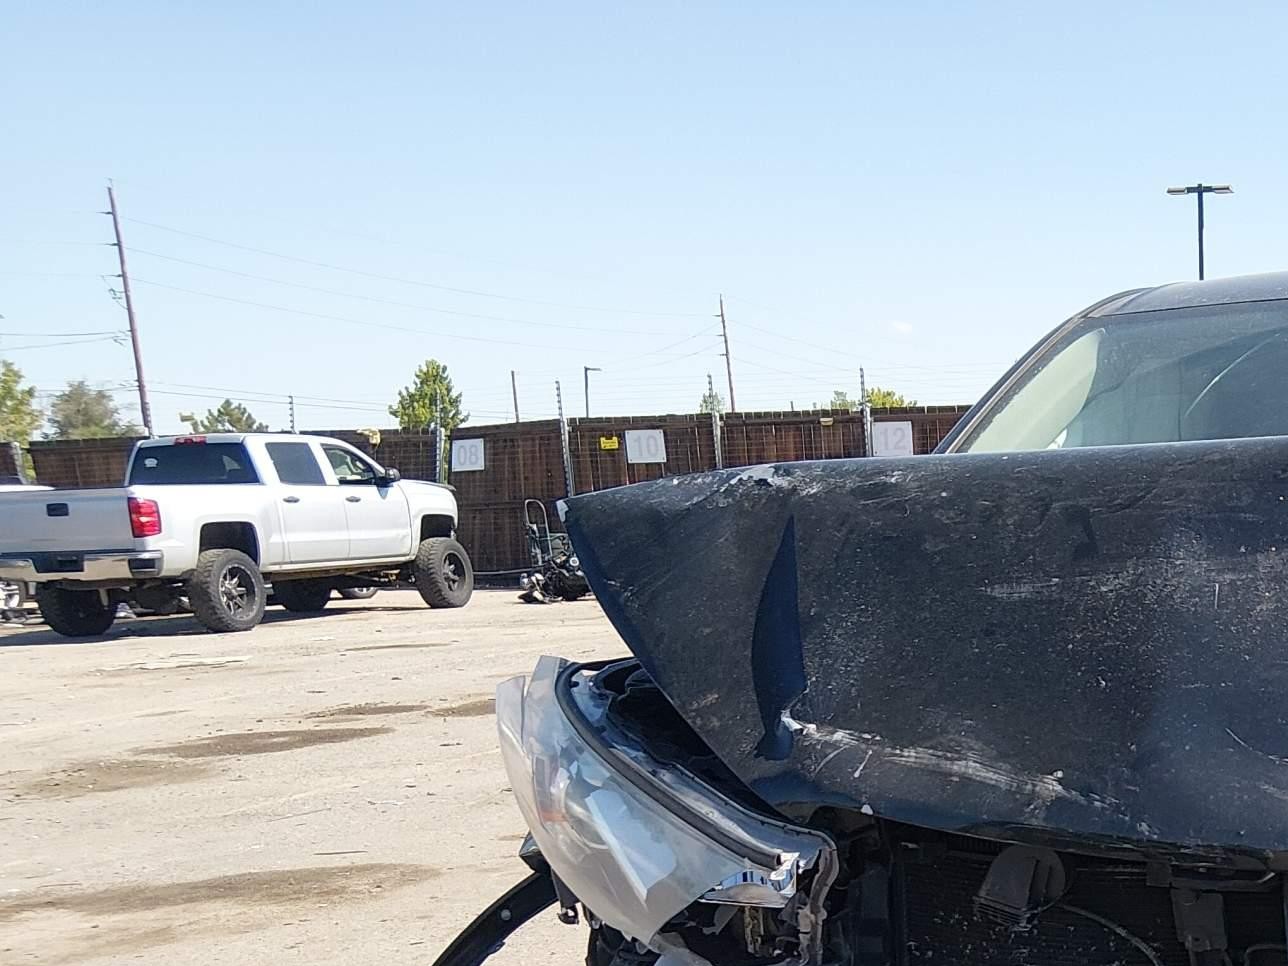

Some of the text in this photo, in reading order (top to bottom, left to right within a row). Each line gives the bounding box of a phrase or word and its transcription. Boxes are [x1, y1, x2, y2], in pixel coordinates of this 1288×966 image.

[634, 434, 660, 458] 10
[879, 426, 906, 451] 12
[456, 444, 480, 466] 08
